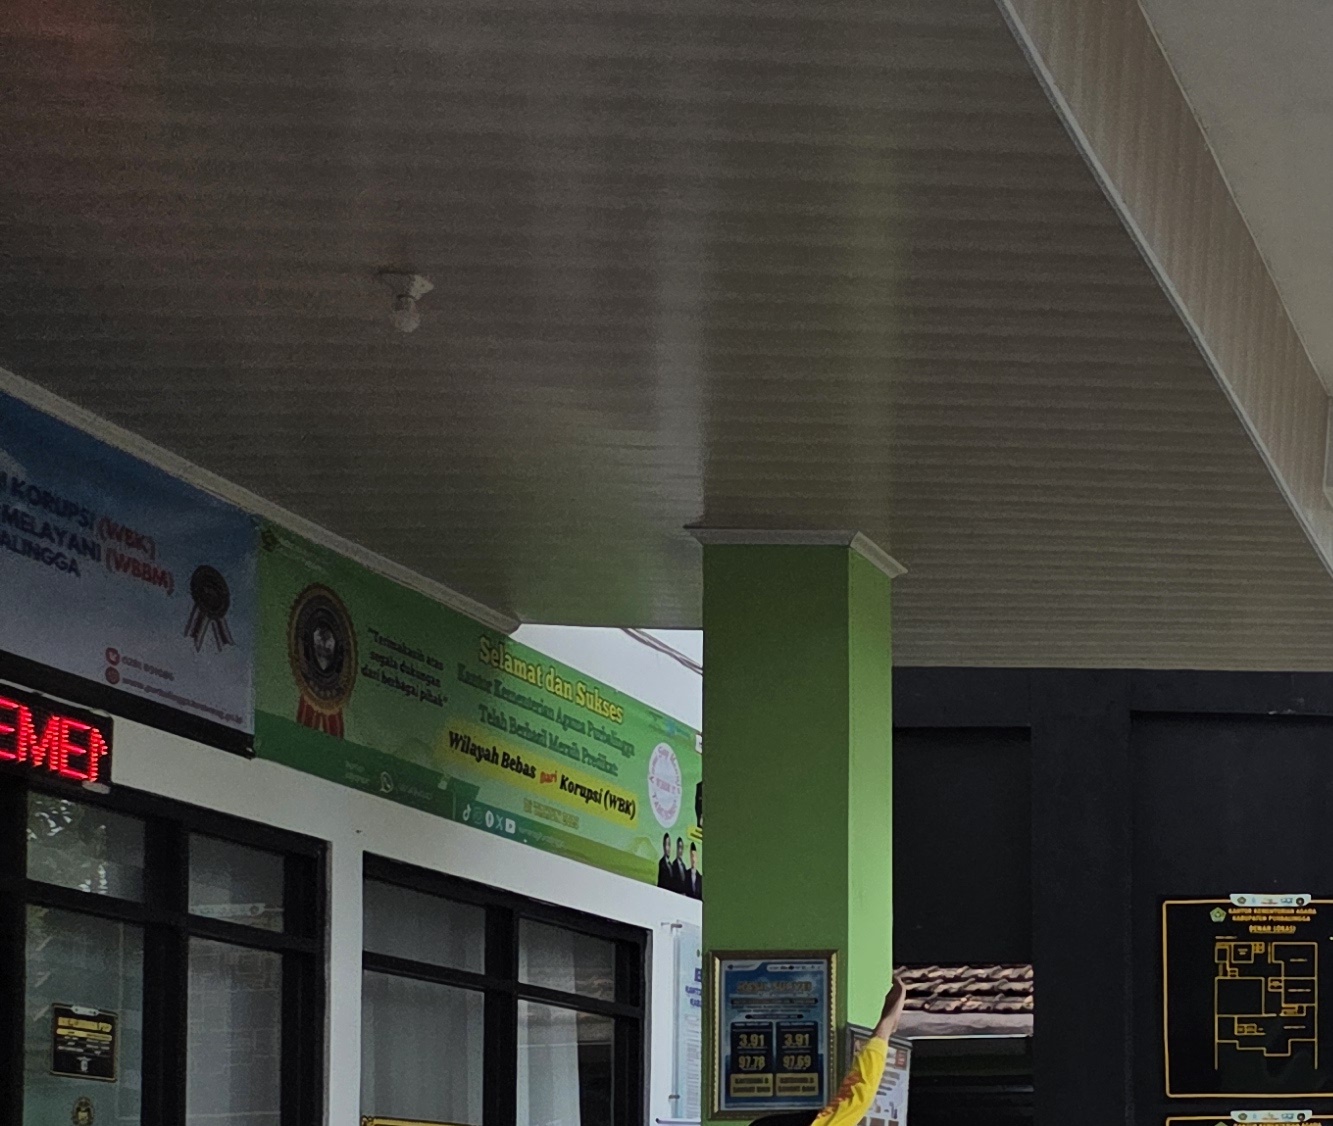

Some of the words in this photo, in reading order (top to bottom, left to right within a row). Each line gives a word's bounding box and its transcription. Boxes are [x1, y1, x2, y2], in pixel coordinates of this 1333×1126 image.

[479, 634, 543, 689] Selamat
[545, 668, 574, 702] dan
[575, 682, 624, 725] Sukses
[449, 731, 500, 765] Wilayah
[501, 750, 537, 779] Bebas
[560, 774, 604, 805] Korupsi
[604, 789, 637, 821] (WBK)
